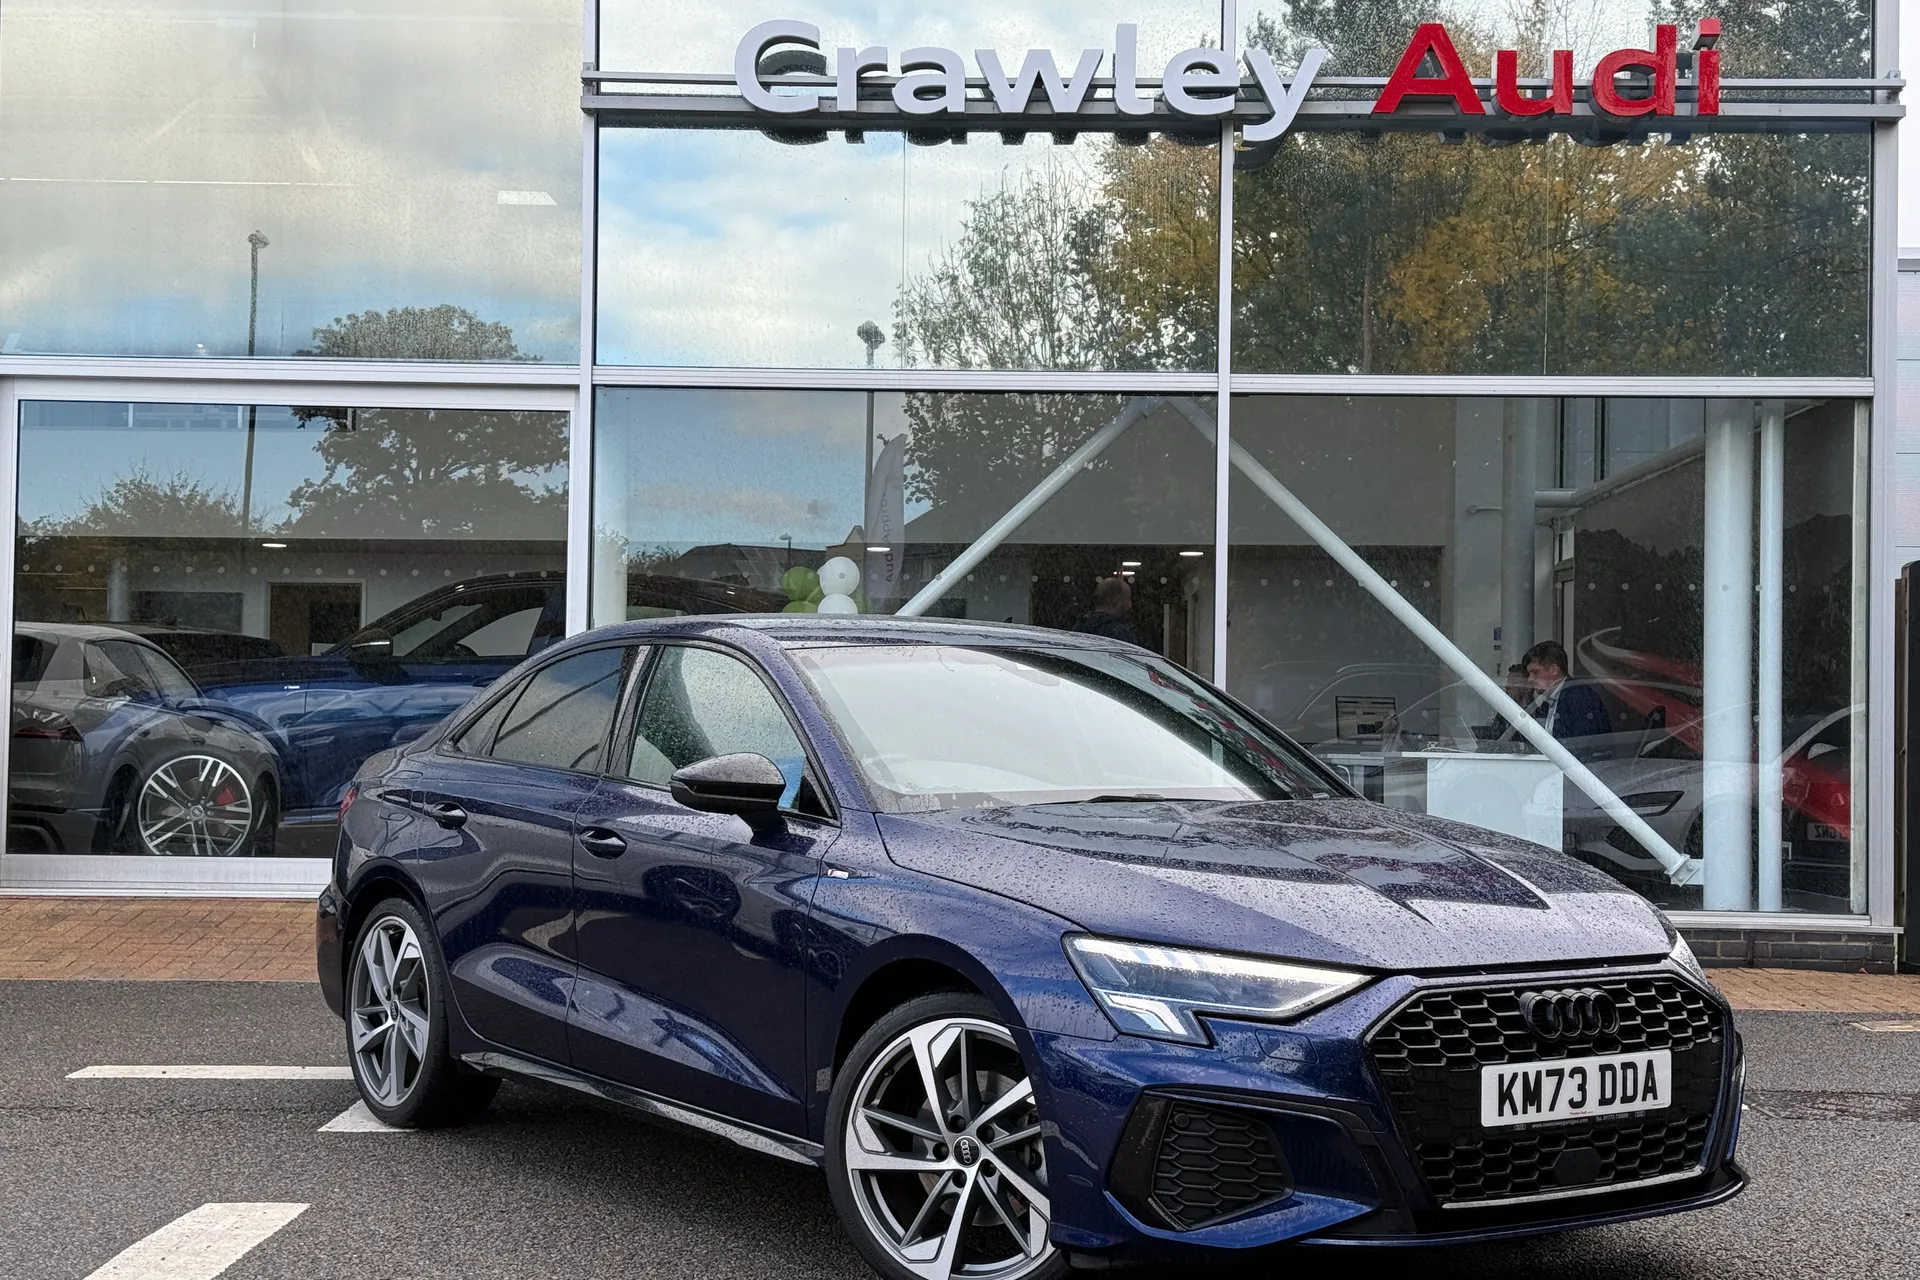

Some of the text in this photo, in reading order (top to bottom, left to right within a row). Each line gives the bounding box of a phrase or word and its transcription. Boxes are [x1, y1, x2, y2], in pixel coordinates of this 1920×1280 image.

[734, 18, 1720, 141] Crawley Audi
[884, 547, 895, 582] Aud
[1497, 1058, 1659, 1117] KM73 DDA
